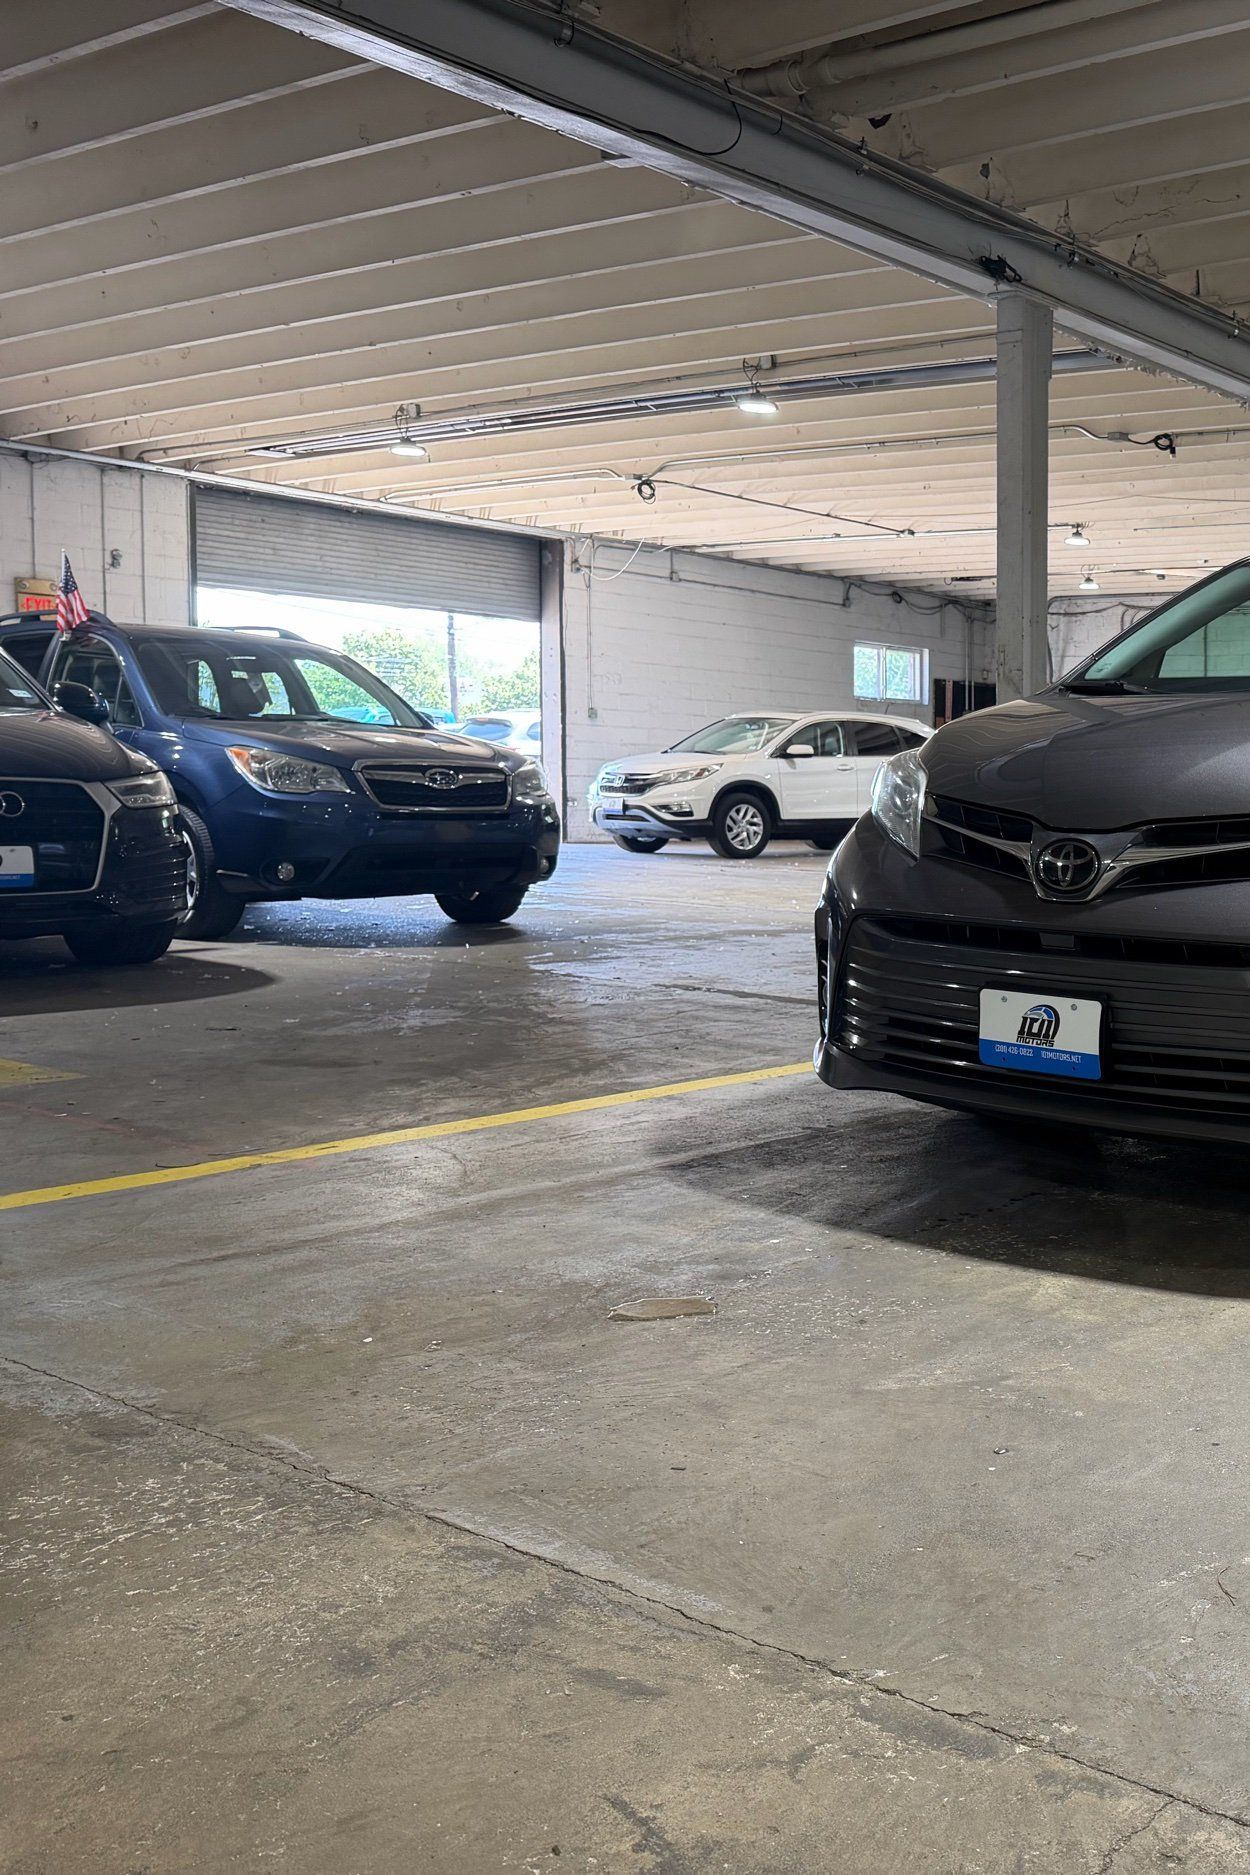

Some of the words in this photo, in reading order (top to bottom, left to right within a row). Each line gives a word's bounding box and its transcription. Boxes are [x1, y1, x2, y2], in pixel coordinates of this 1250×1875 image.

[24, 596, 52, 611] EXIT
[1018, 1016, 1053, 1040] 101
[1016, 1036, 1055, 1047] MOTORS
[1040, 1050, 1082, 1063] 101MOTORS.NET
